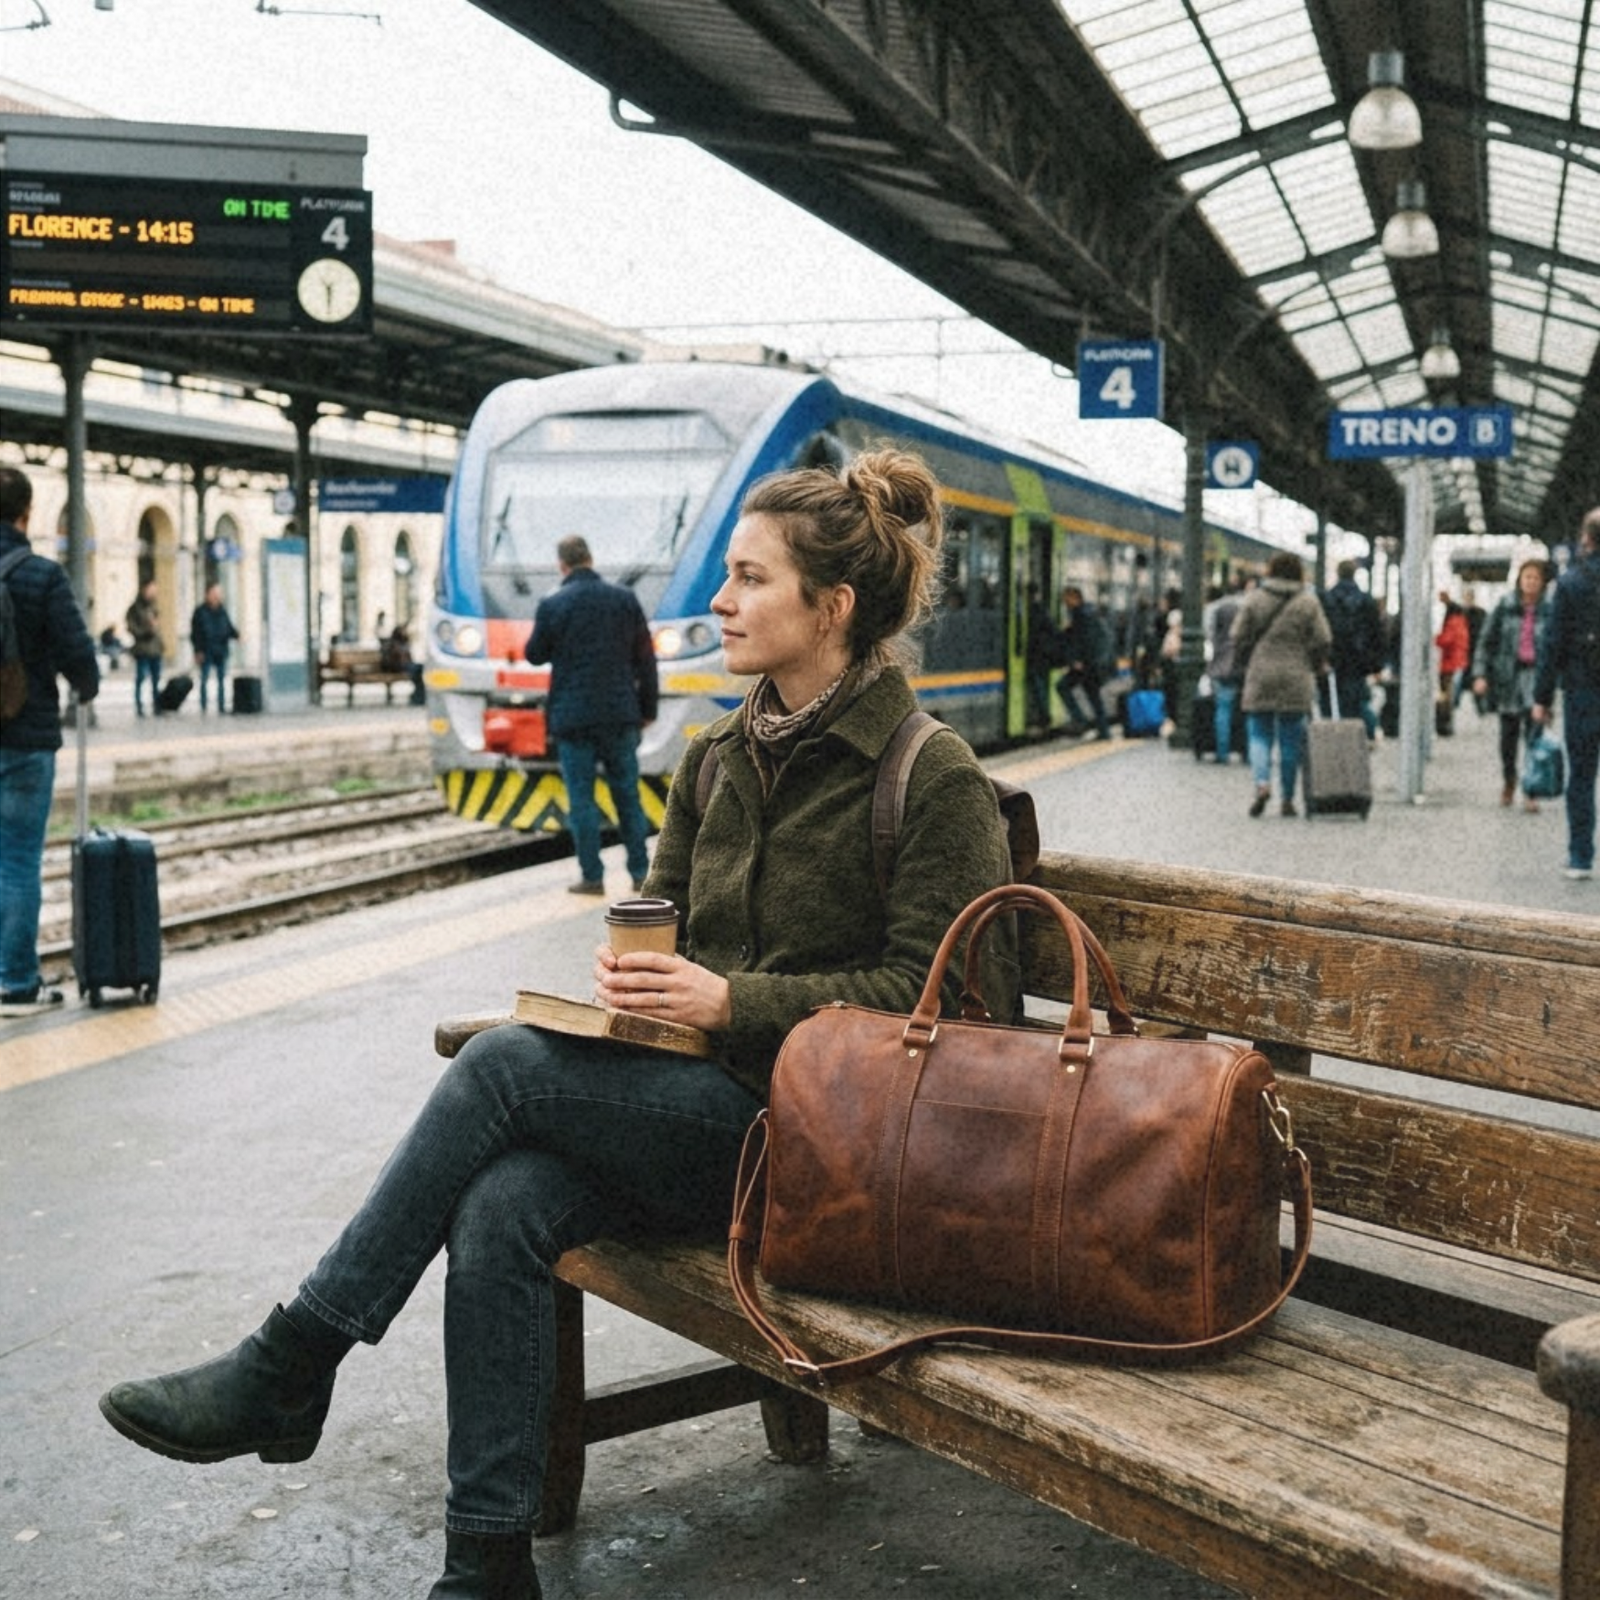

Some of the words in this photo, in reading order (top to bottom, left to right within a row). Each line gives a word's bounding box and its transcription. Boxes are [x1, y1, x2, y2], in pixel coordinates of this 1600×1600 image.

[8, 213, 113, 241] FLORENCE
[137, 219, 194, 244] 14:15
[321, 216, 350, 251] 4
[1099, 366, 1137, 409] 4
[1341, 416, 1457, 446] TRENO
